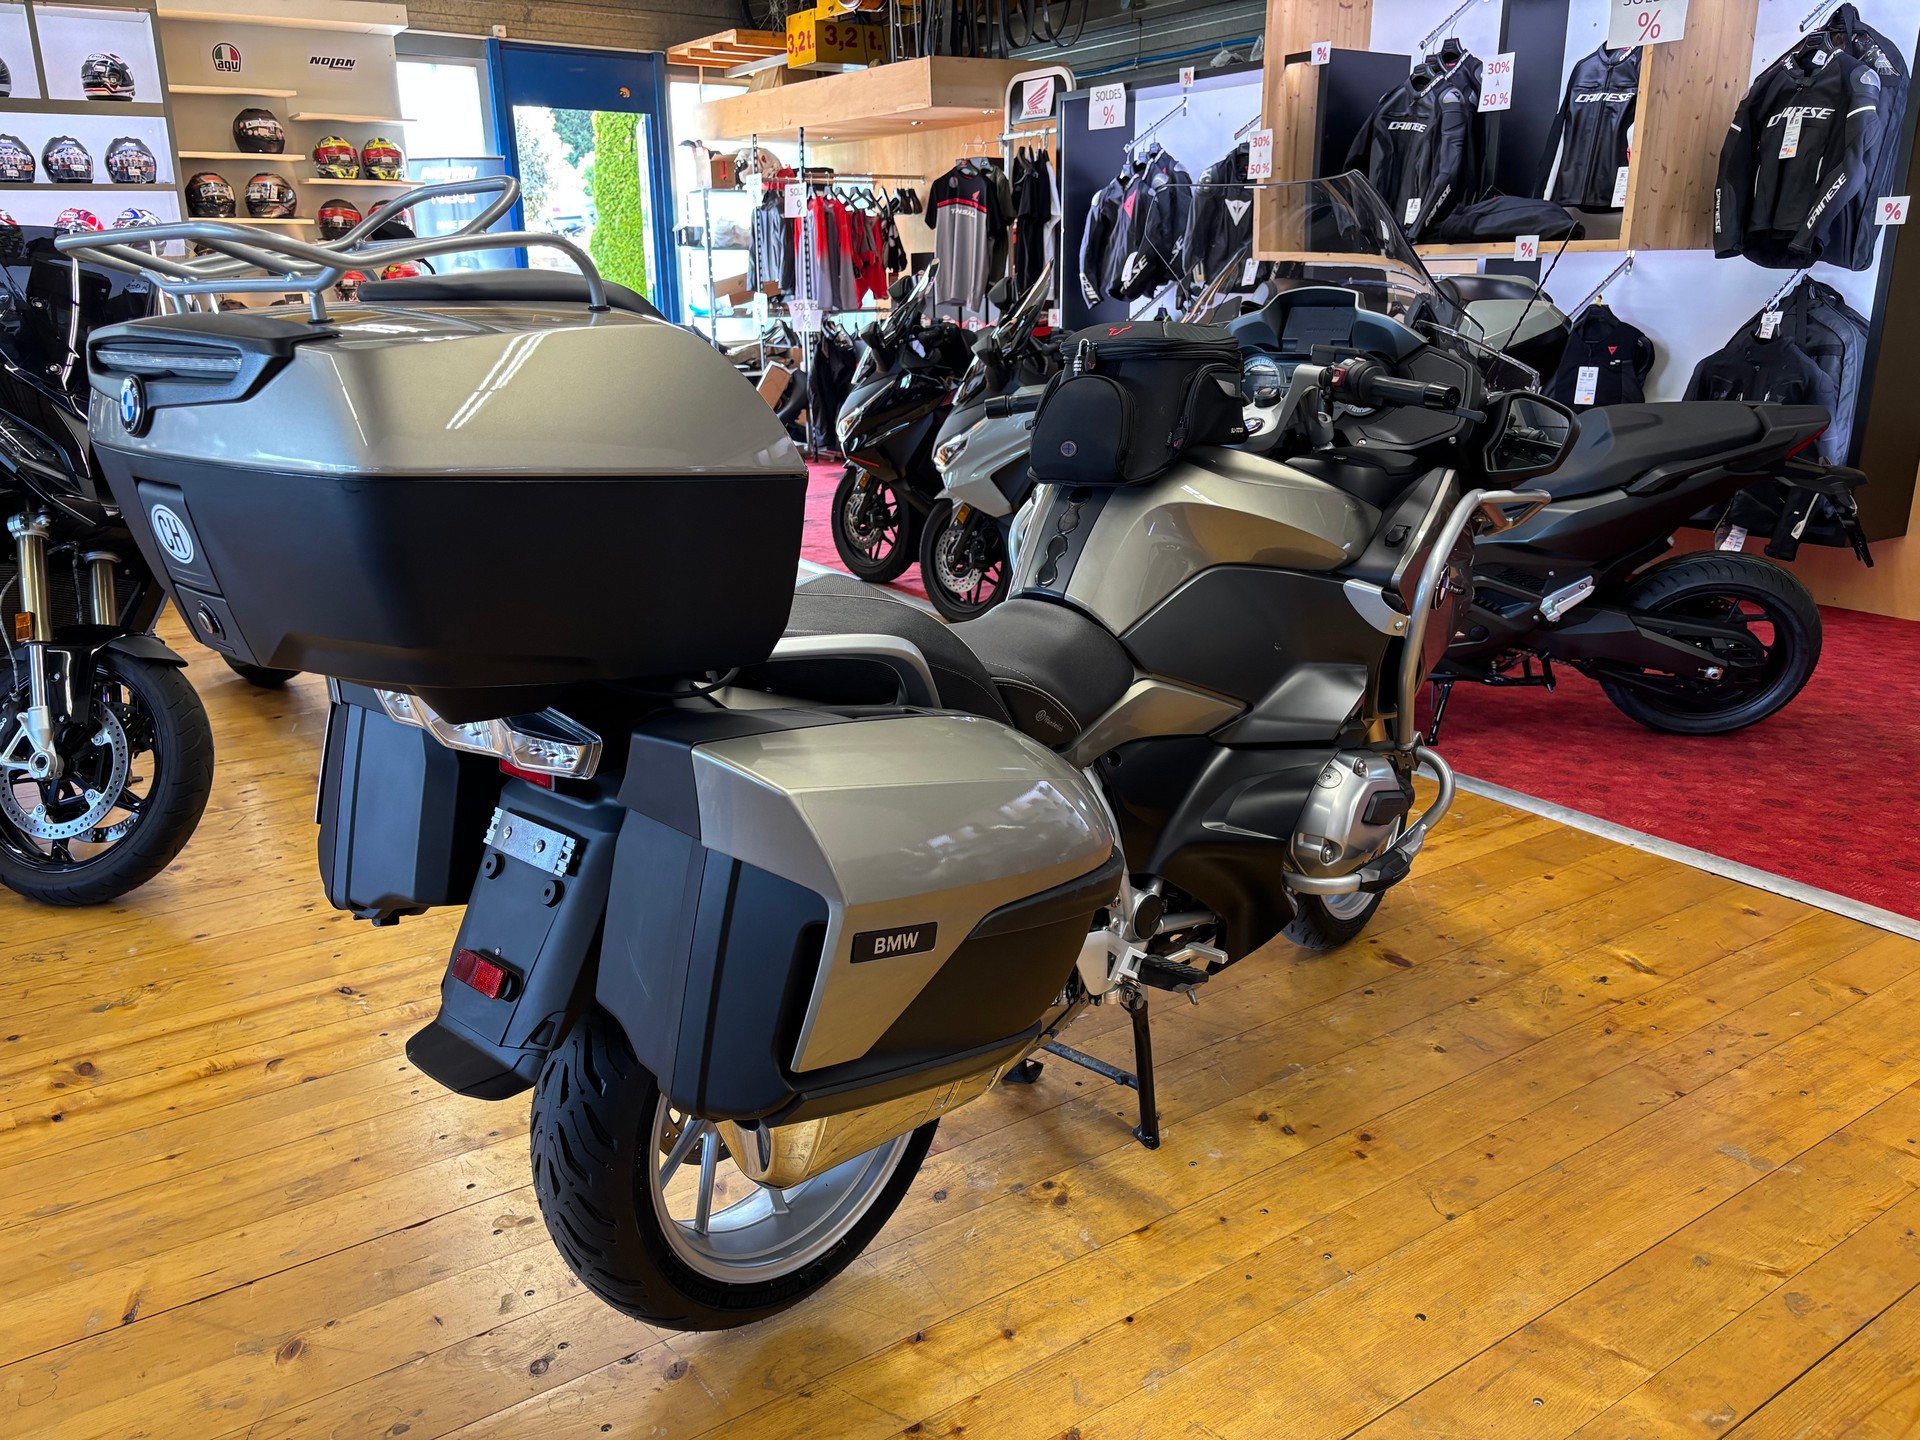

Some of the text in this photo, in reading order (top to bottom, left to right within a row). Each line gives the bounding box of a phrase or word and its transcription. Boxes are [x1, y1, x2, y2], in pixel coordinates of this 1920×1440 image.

[1638, 9, 1661, 41] %
[825, 25, 858, 51] 3,2
[1317, 47, 1327, 61] %
[217, 60, 239, 72] agv
[309, 56, 356, 71] NOLAN
[1488, 60, 1510, 75] 30%
[1184, 71, 1192, 85] %
[1095, 88, 1122, 102] SOLDES
[1483, 92, 1509, 106] 50 %
[1574, 92, 1636, 103] DAINESE
[1103, 105, 1115, 126] %
[1252, 136, 1270, 148] 30%
[1250, 162, 1270, 175] 50 %
[1806, 172, 1847, 230] DAINESE
[1885, 202, 1901, 221] %
[1520, 242, 1533, 258] %
[157, 515, 188, 554] CH
[874, 932, 919, 954] BMW
